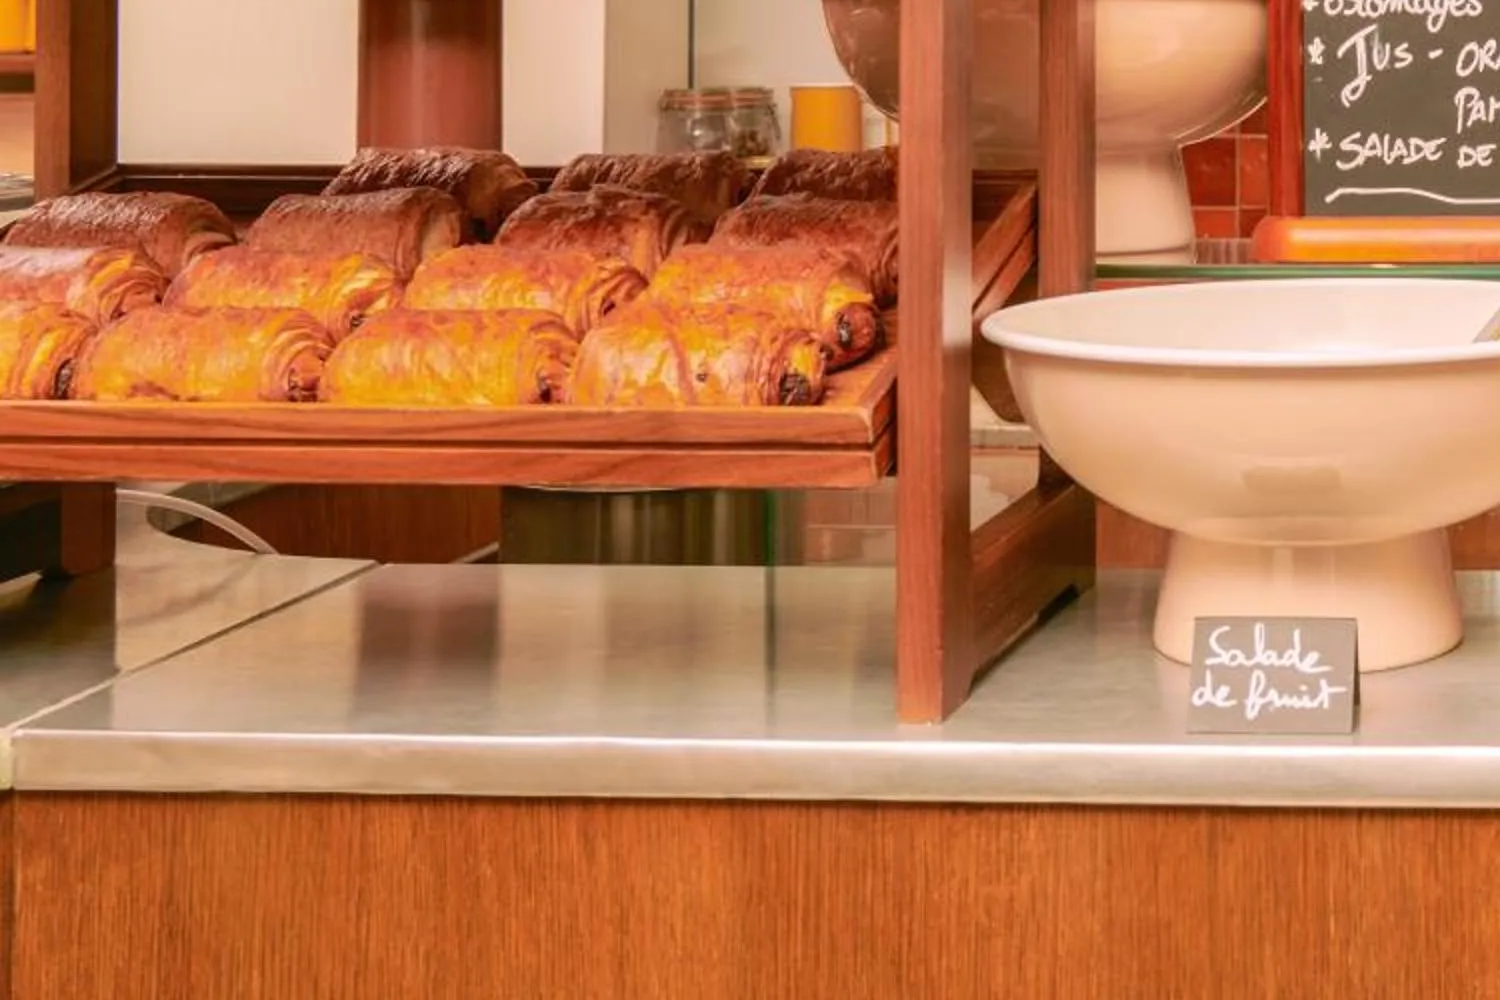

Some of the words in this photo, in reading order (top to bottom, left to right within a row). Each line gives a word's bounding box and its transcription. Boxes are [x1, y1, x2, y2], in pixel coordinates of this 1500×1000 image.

[1335, 132, 1447, 171] SALADE
[1457, 147, 1495, 169] DE
[1204, 622, 1334, 673] Salade
[1191, 668, 1238, 708] de
[1245, 669, 1348, 721] fruit
